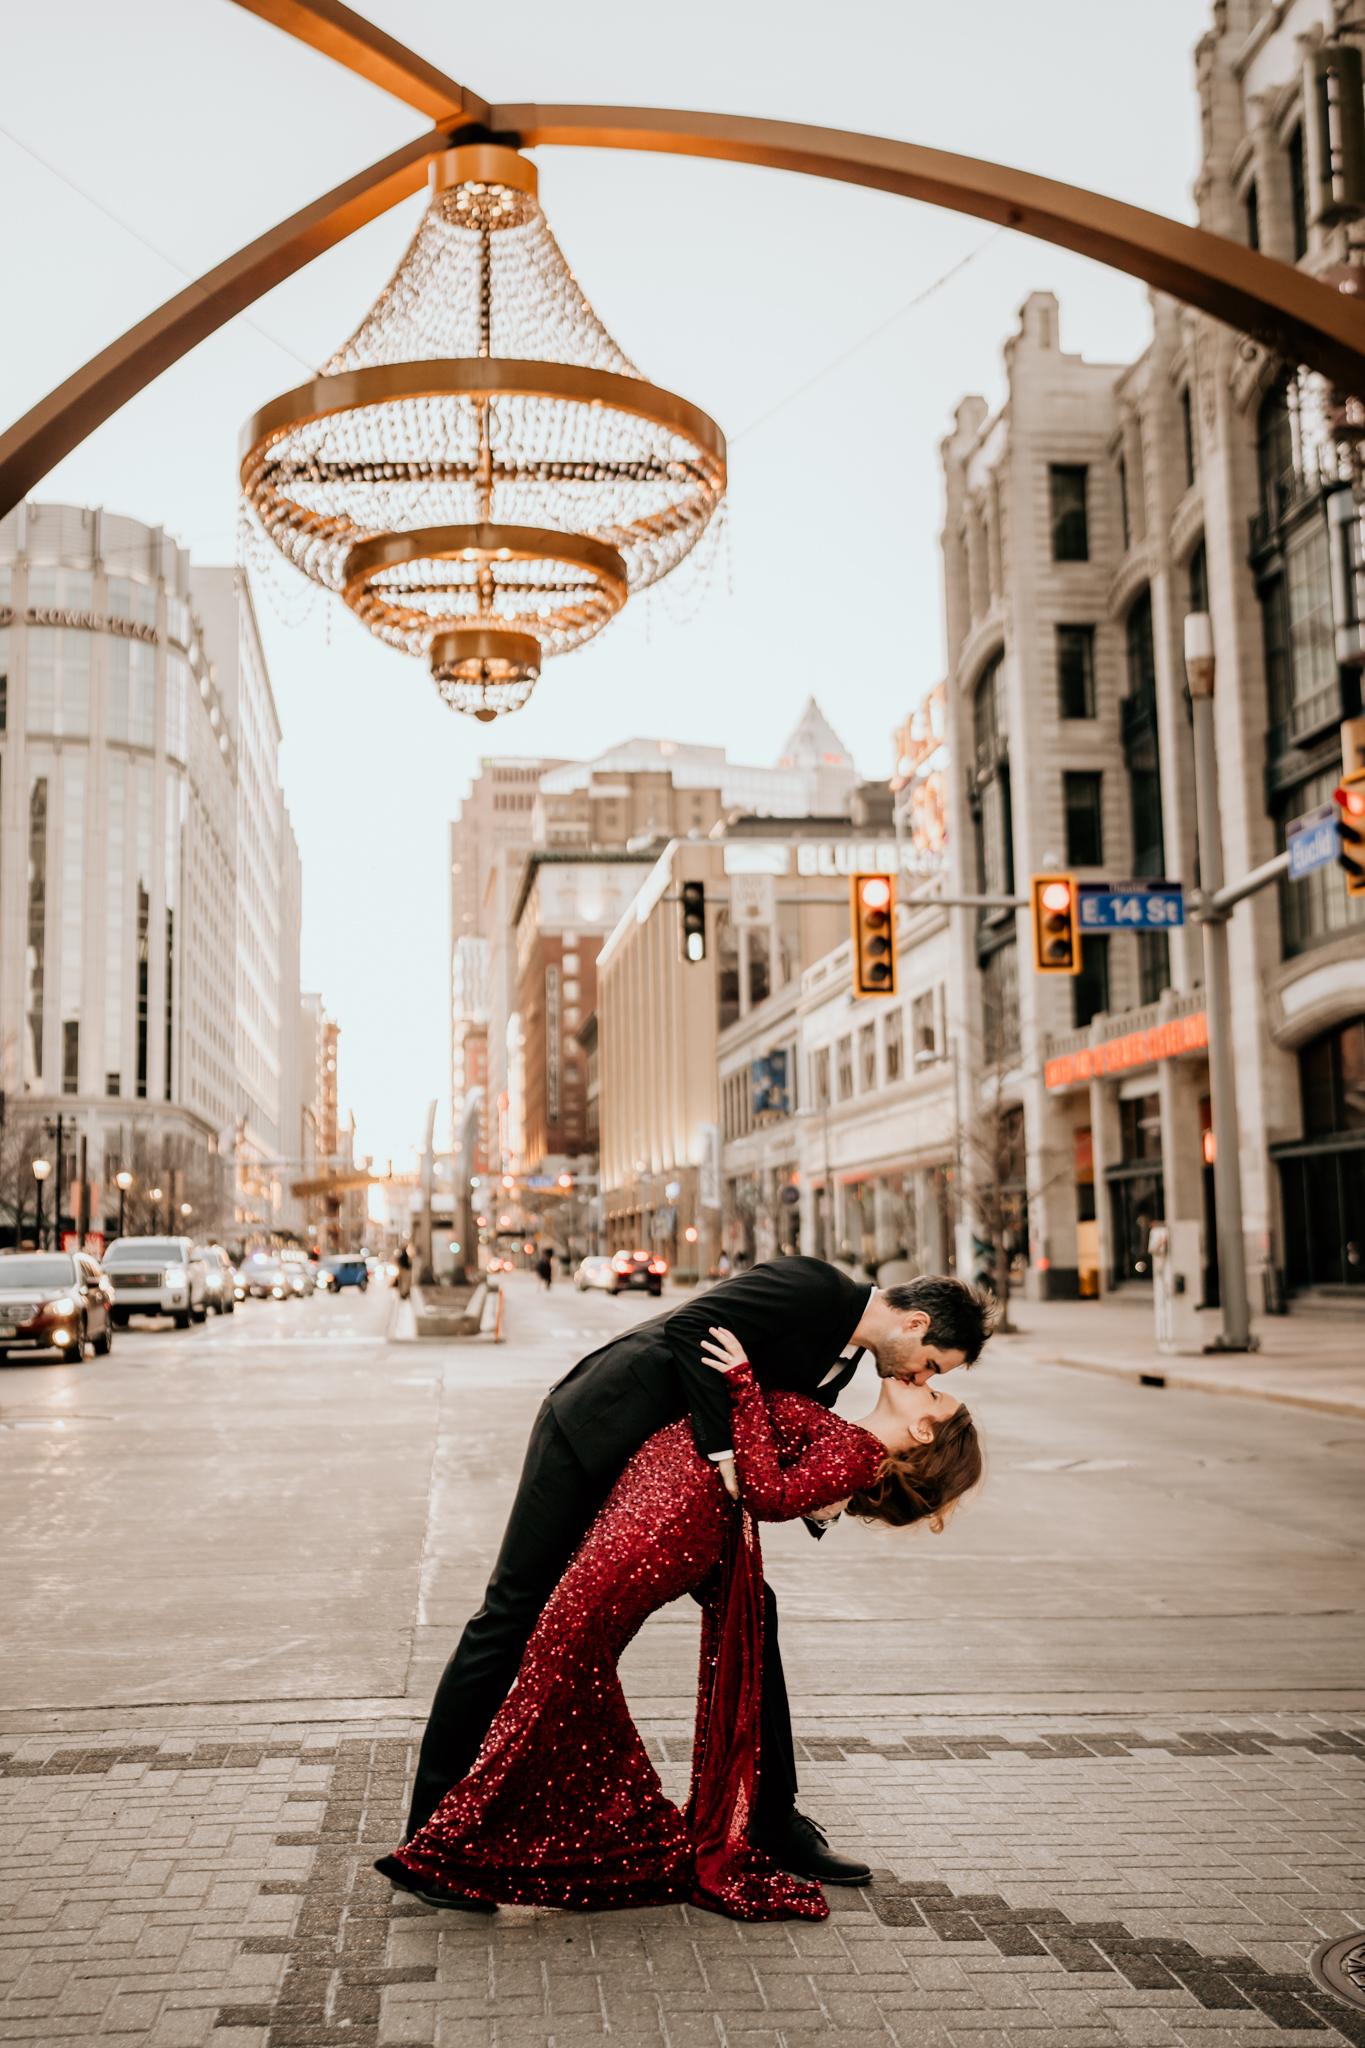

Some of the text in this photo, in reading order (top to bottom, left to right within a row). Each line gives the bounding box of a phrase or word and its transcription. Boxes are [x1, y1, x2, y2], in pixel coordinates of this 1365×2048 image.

[1293, 828, 1332, 870] Euclid
[1082, 897, 1178, 923] E. 14 St
